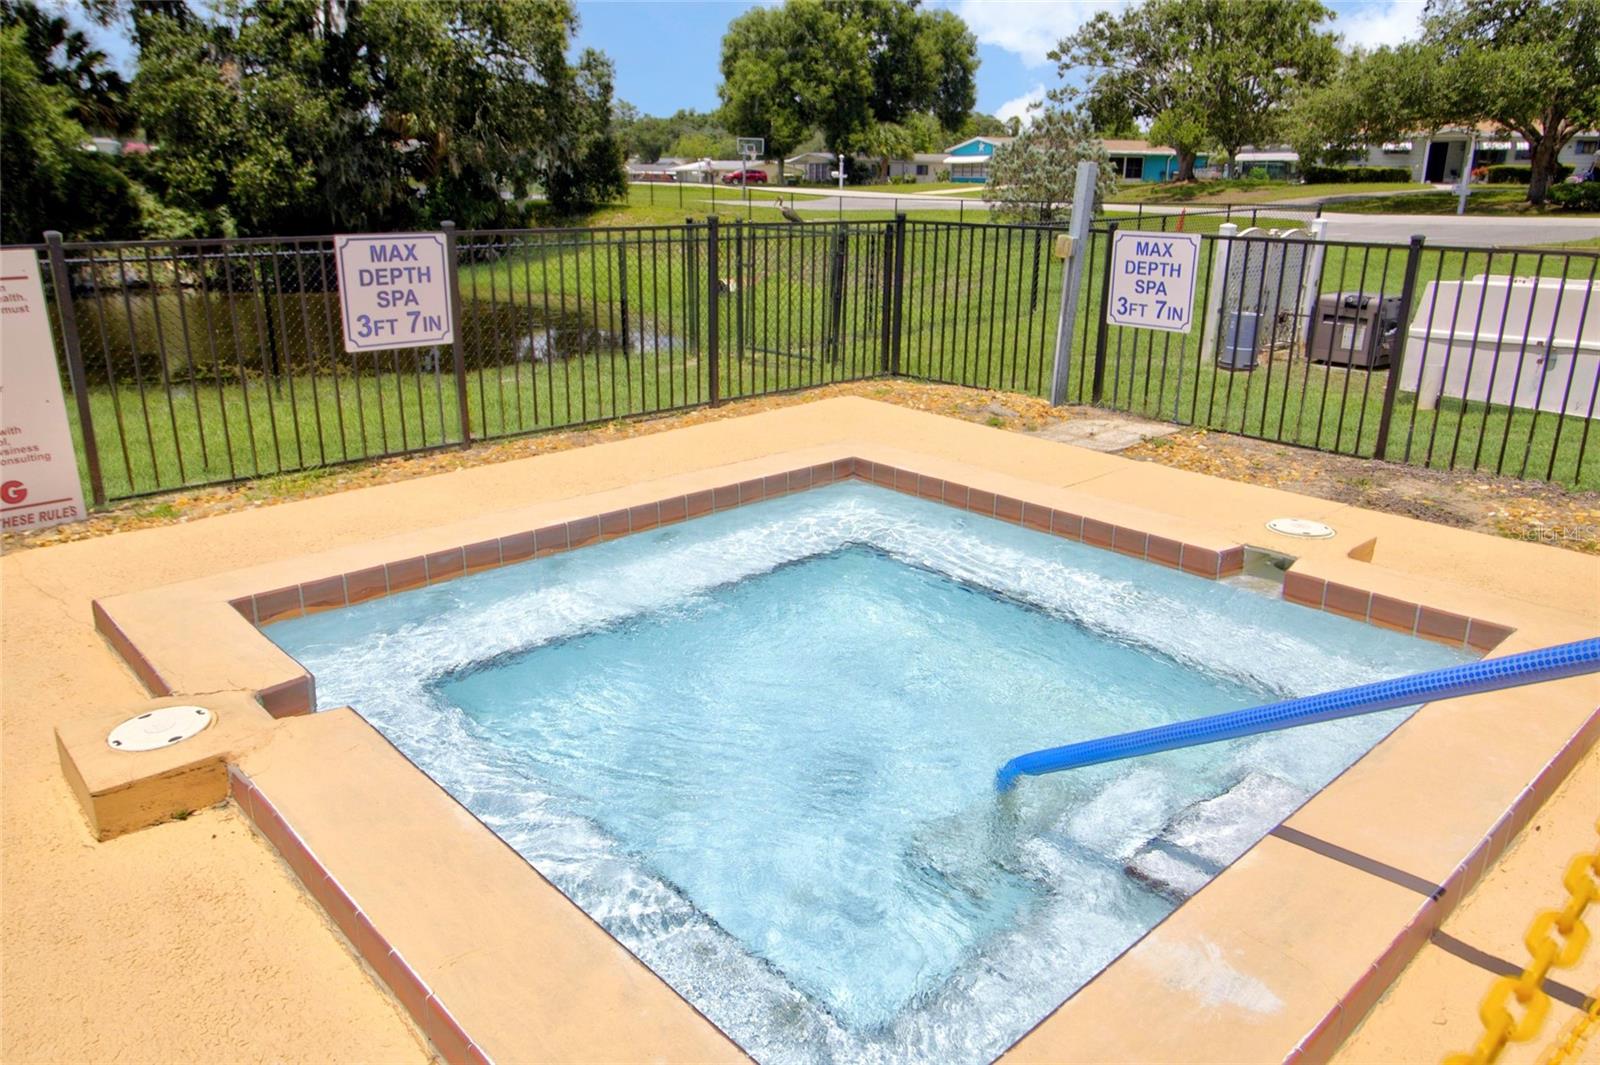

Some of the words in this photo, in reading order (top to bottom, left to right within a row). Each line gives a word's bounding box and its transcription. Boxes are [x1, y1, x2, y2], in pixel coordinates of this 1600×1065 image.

[370, 244, 418, 262] MAX
[1136, 241, 1173, 258] MAX
[359, 266, 431, 287] DEPTH
[1125, 260, 1182, 278] DEPTH
[1135, 279, 1167, 296] SPA
[377, 289, 419, 308] SPA
[1, 305, 30, 313] must
[1117, 296, 1148, 317] 3FT
[1155, 300, 1184, 322] 7IN
[356, 314, 398, 338] 3FT
[406, 311, 442, 333] 7IN
[0, 453, 51, 466] onsulting
[1, 480, 27, 504] G
[0, 513, 35, 528] HESE
[39, 505, 78, 522] RULES
